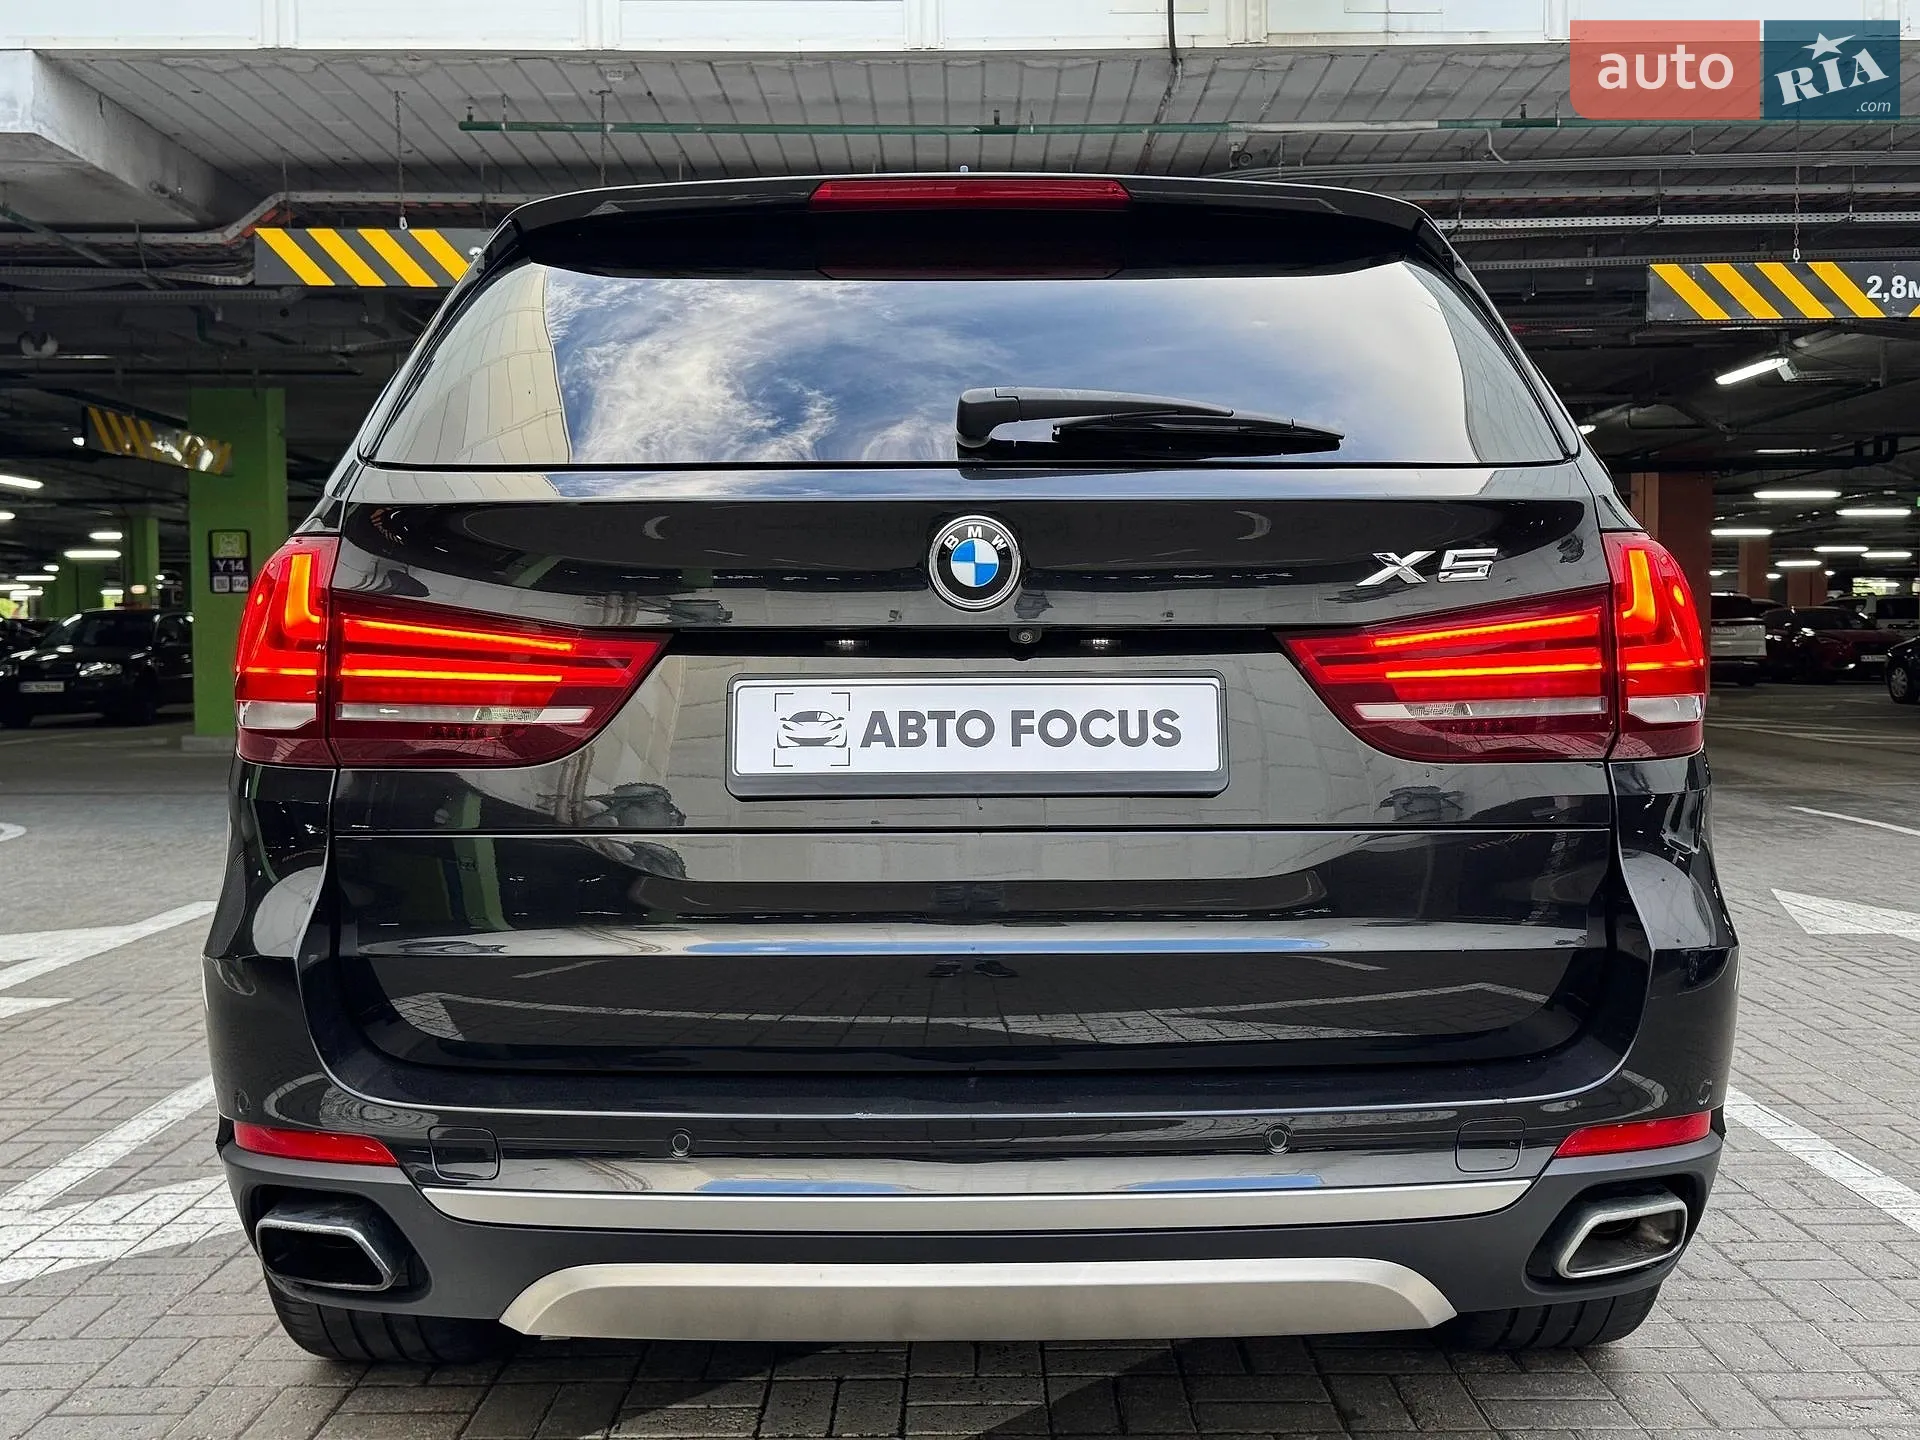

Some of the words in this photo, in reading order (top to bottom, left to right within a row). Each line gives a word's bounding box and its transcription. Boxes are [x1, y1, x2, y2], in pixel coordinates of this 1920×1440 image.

[944, 526, 1007, 550] BMW
[1356, 548, 1498, 586] X5
[860, 710, 995, 747] АВТО
[1011, 709, 1182, 747] FOCUS
